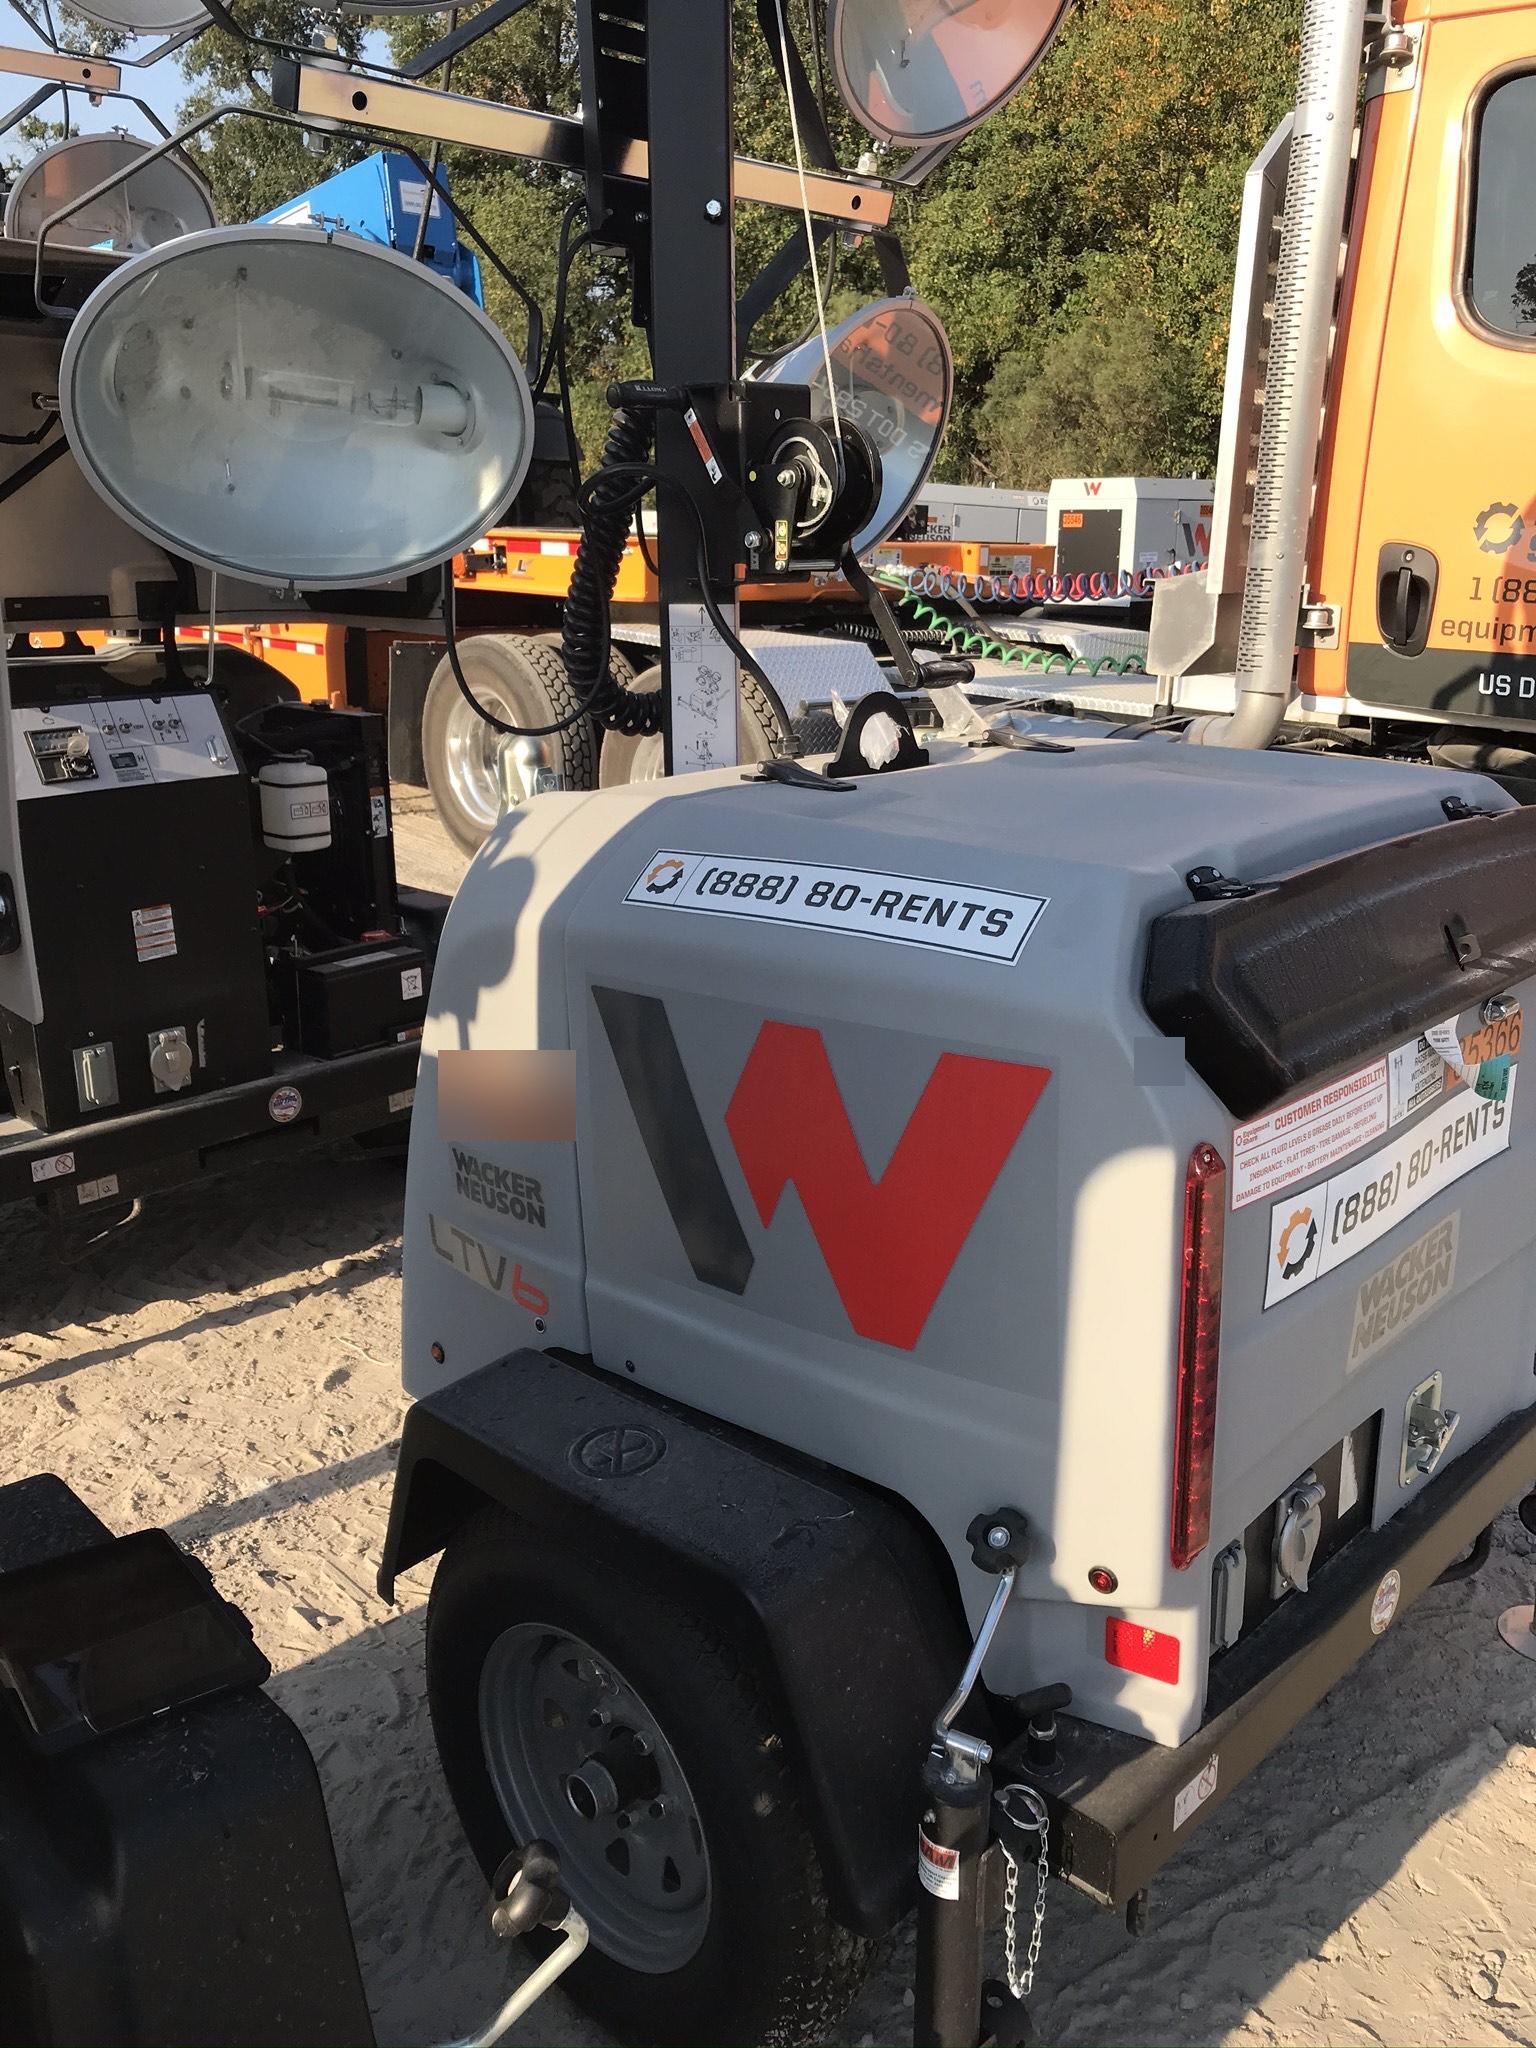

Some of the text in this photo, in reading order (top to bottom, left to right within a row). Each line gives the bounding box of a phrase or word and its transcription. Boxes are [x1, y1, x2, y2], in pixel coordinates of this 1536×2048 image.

[1469, 577, 1482, 600] 1
[1479, 673, 1511, 696] US
[695, 867, 1014, 938] (888) 80-RENTS
[1242, 1121, 1270, 1137] Equipment
[1274, 1066, 1386, 1131] CUSTOMER RESPONSIBILITY
[1236, 1185, 1261, 1203] DAMAGE
[1262, 1180, 1270, 1190] TO
[1271, 1166, 1304, 1186] EQUIPMENT
[1307, 1156, 1330, 1169] BATTERY
[1330, 1136, 1362, 1158] MAINTENANCE
[1240, 1156, 1260, 1170] CHECK
[1260, 1151, 1270, 1162] ALL
[1271, 1143, 1288, 1157] FLUID
[1289, 1135, 1306, 1149] LEVELS
[1313, 1123, 1331, 1137] GREASE
[1332, 1115, 1346, 1129] DAILY
[1347, 1107, 1363, 1120] BEFORE
[1249, 1160, 1283, 1182] INSURANCE
[1287, 1153, 1300, 1164] FLAT
[1300, 1145, 1316, 1158] TIRES
[1319, 1138, 1331, 1149] TIRE
[1331, 1128, 1351, 1143] DAMAGE
[452, 1147, 544, 1203] WACKER
[456, 1172, 546, 1229] NEUSON
[1331, 1100, 1506, 1245] (888) 80-RENTS
[1360, 1220, 1453, 1316] WACKER
[1352, 1252, 1450, 1358] NEUSON
